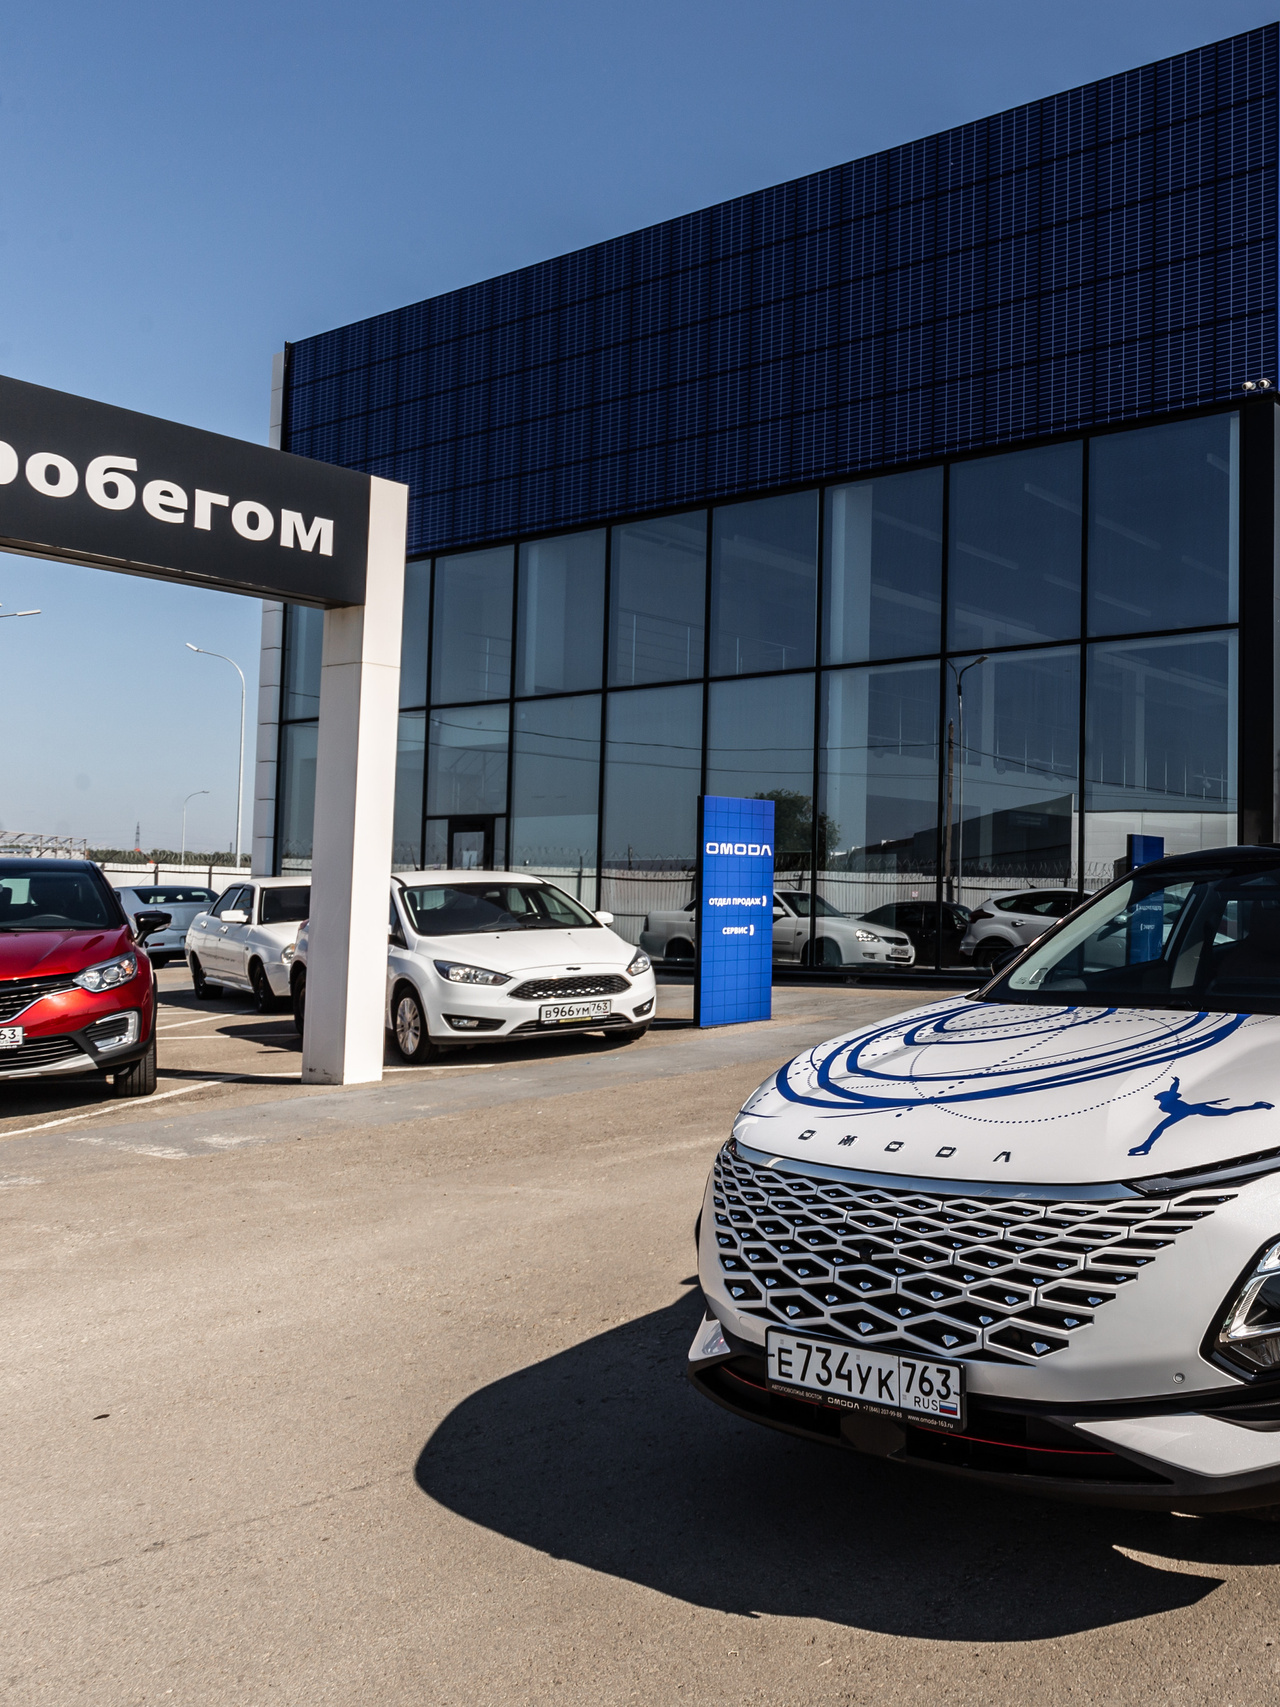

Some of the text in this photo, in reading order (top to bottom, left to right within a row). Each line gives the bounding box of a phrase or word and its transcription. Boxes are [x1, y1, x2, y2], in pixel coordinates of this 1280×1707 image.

[706, 842, 772, 856] OMODA
[709, 897, 761, 906] ОТДЕЛ ПРОДАЖ
[722, 926, 748, 935] СЕРВИС
[591, 1002, 608, 1012] 763
[798, 1129, 1012, 1163] OMODA
[902, 1361, 951, 1400] 763
[827, 1397, 860, 1409] OMODA
[914, 1396, 938, 1411] RUS
